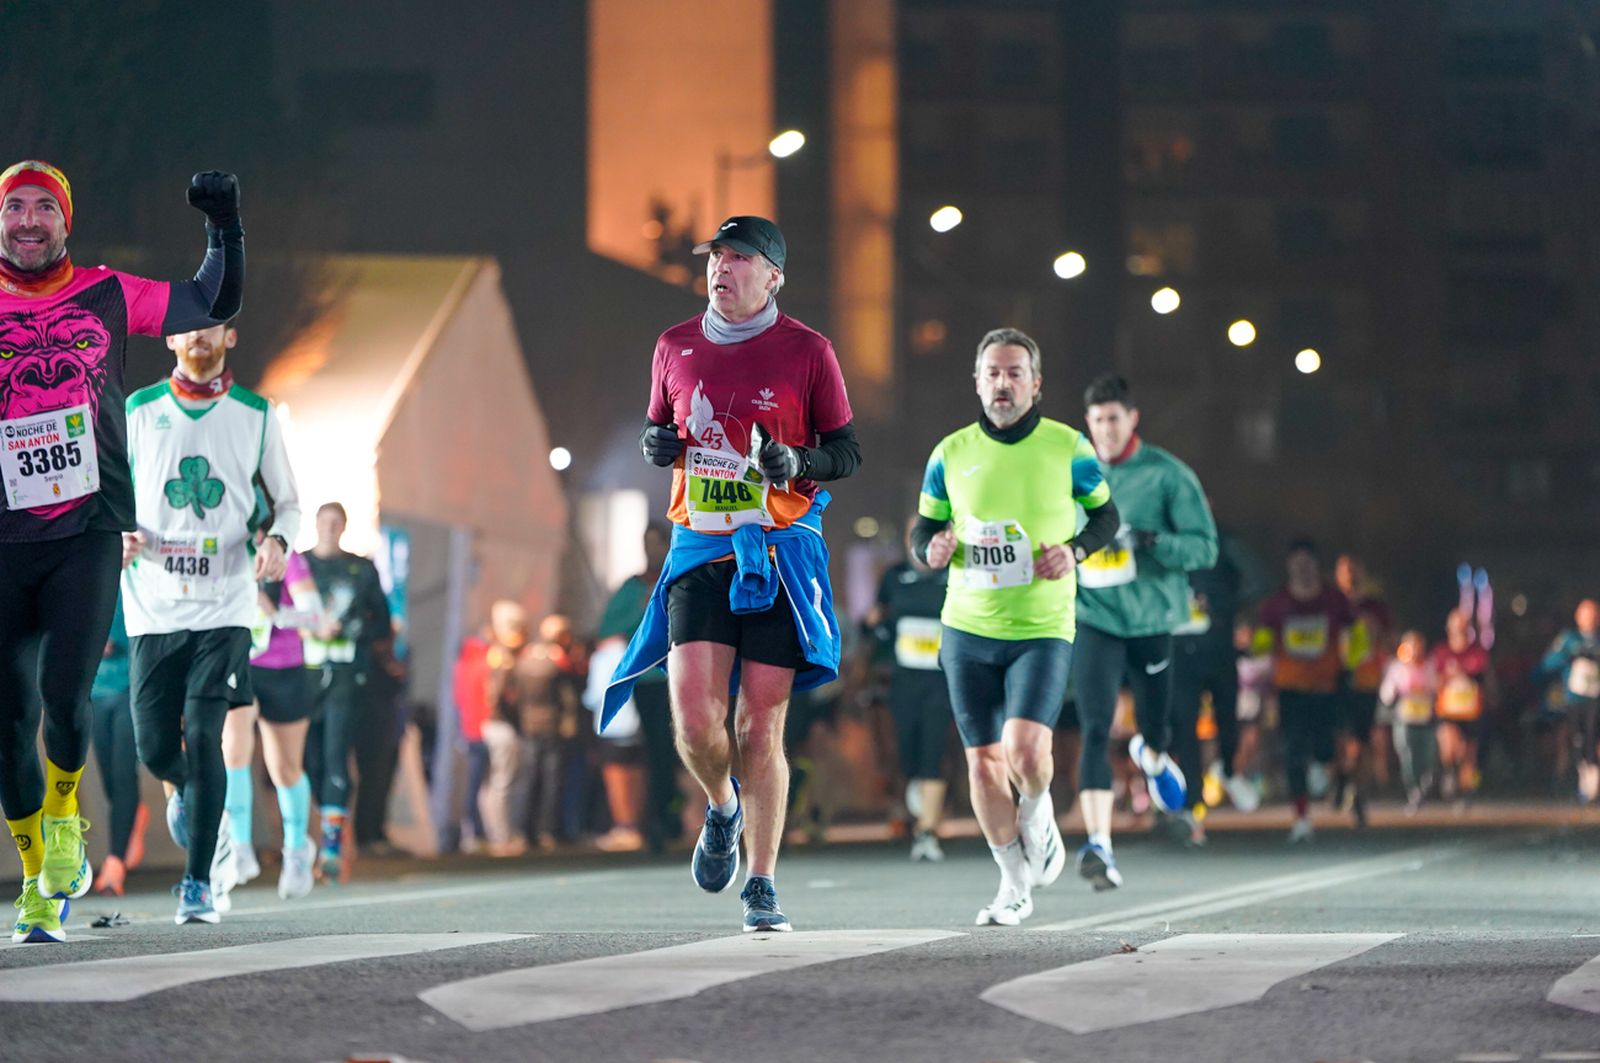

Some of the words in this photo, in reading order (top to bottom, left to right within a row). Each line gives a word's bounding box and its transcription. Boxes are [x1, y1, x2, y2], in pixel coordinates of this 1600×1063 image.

[16, 424, 45, 438] NOCHE
[46, 422, 57, 431] DE
[700, 427, 723, 450] 43
[8, 441, 26, 451] SAN
[17, 440, 82, 477] 3385
[702, 457, 727, 470] NOCHE
[728, 462, 739, 471] DE
[44, 474, 63, 482] Sergio
[693, 466, 708, 477] SAN
[701, 478, 752, 504] 7446
[972, 544, 1016, 566] 6708
[164, 556, 210, 576] 4438
